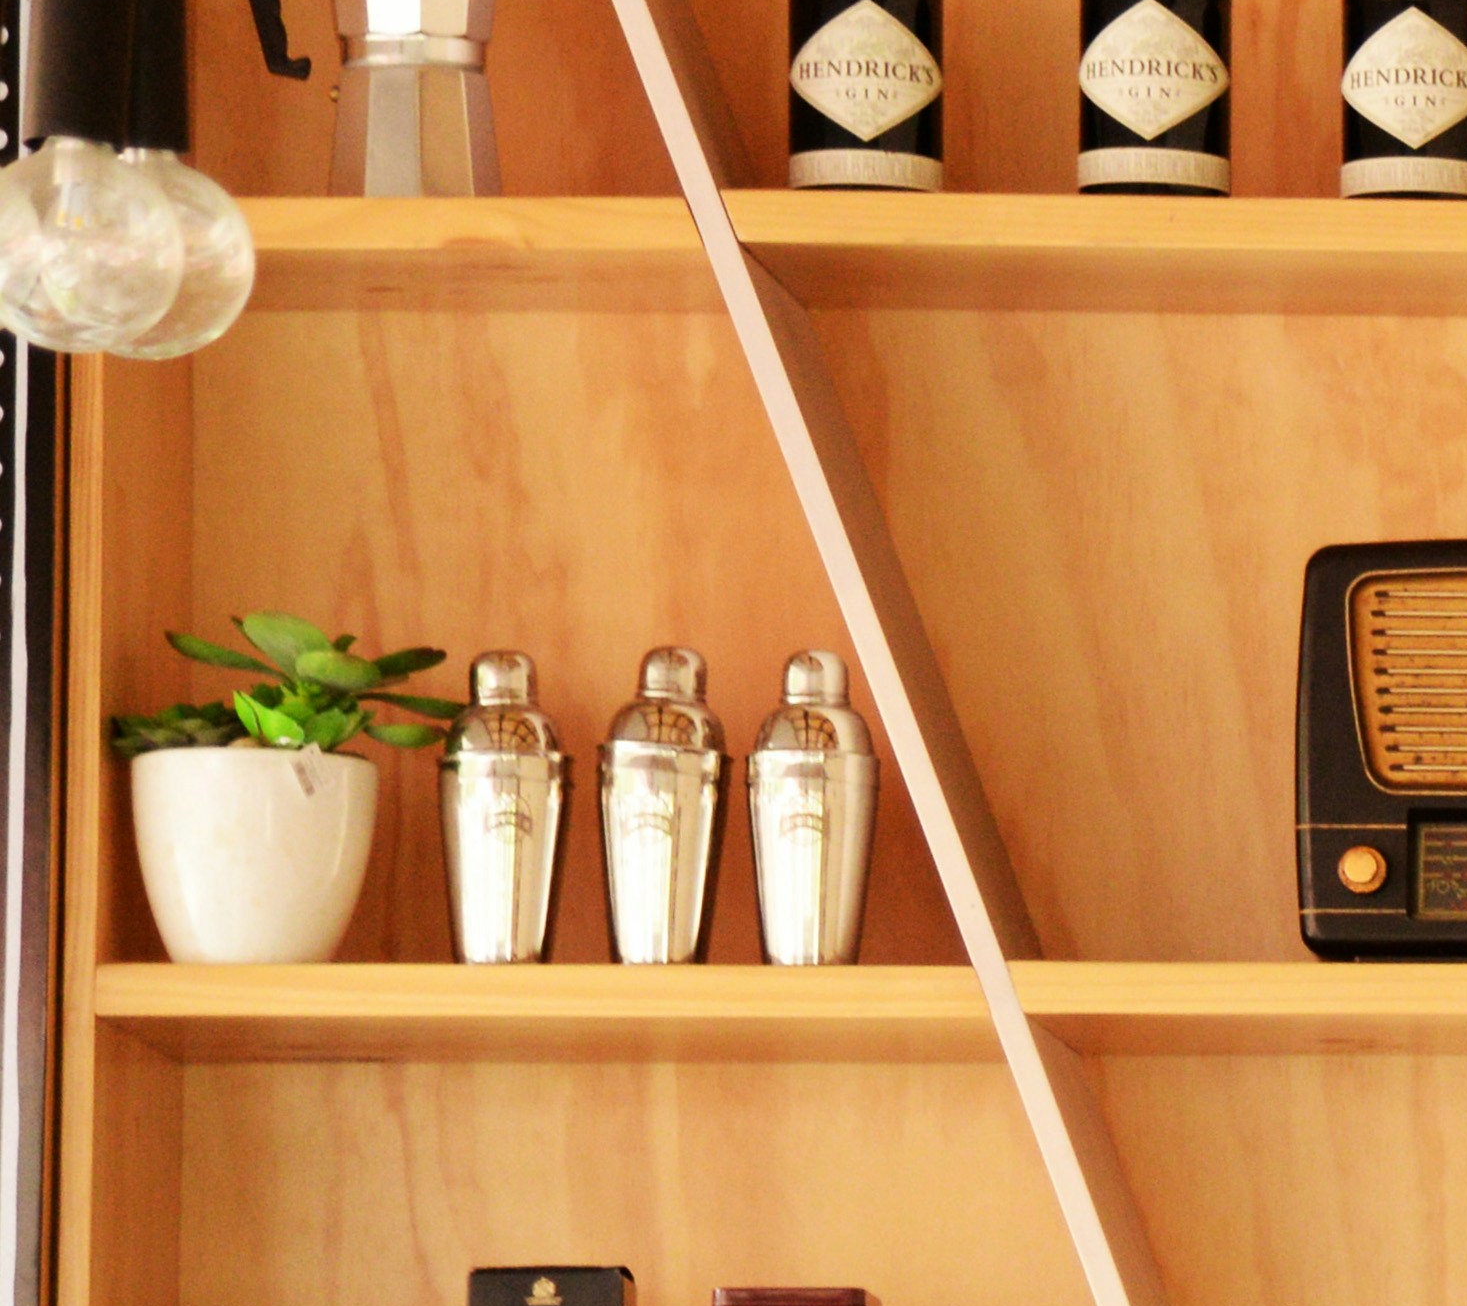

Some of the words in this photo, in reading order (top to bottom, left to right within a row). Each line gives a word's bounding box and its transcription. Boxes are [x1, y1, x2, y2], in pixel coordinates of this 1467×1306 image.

[799, 60, 935, 86] HENDRICK'S
[1086, 57, 1220, 84] HENDRICK'S
[846, 87, 890, 101] GIN
[1128, 85, 1172, 101] GIN
[1394, 94, 1439, 108] GIN
